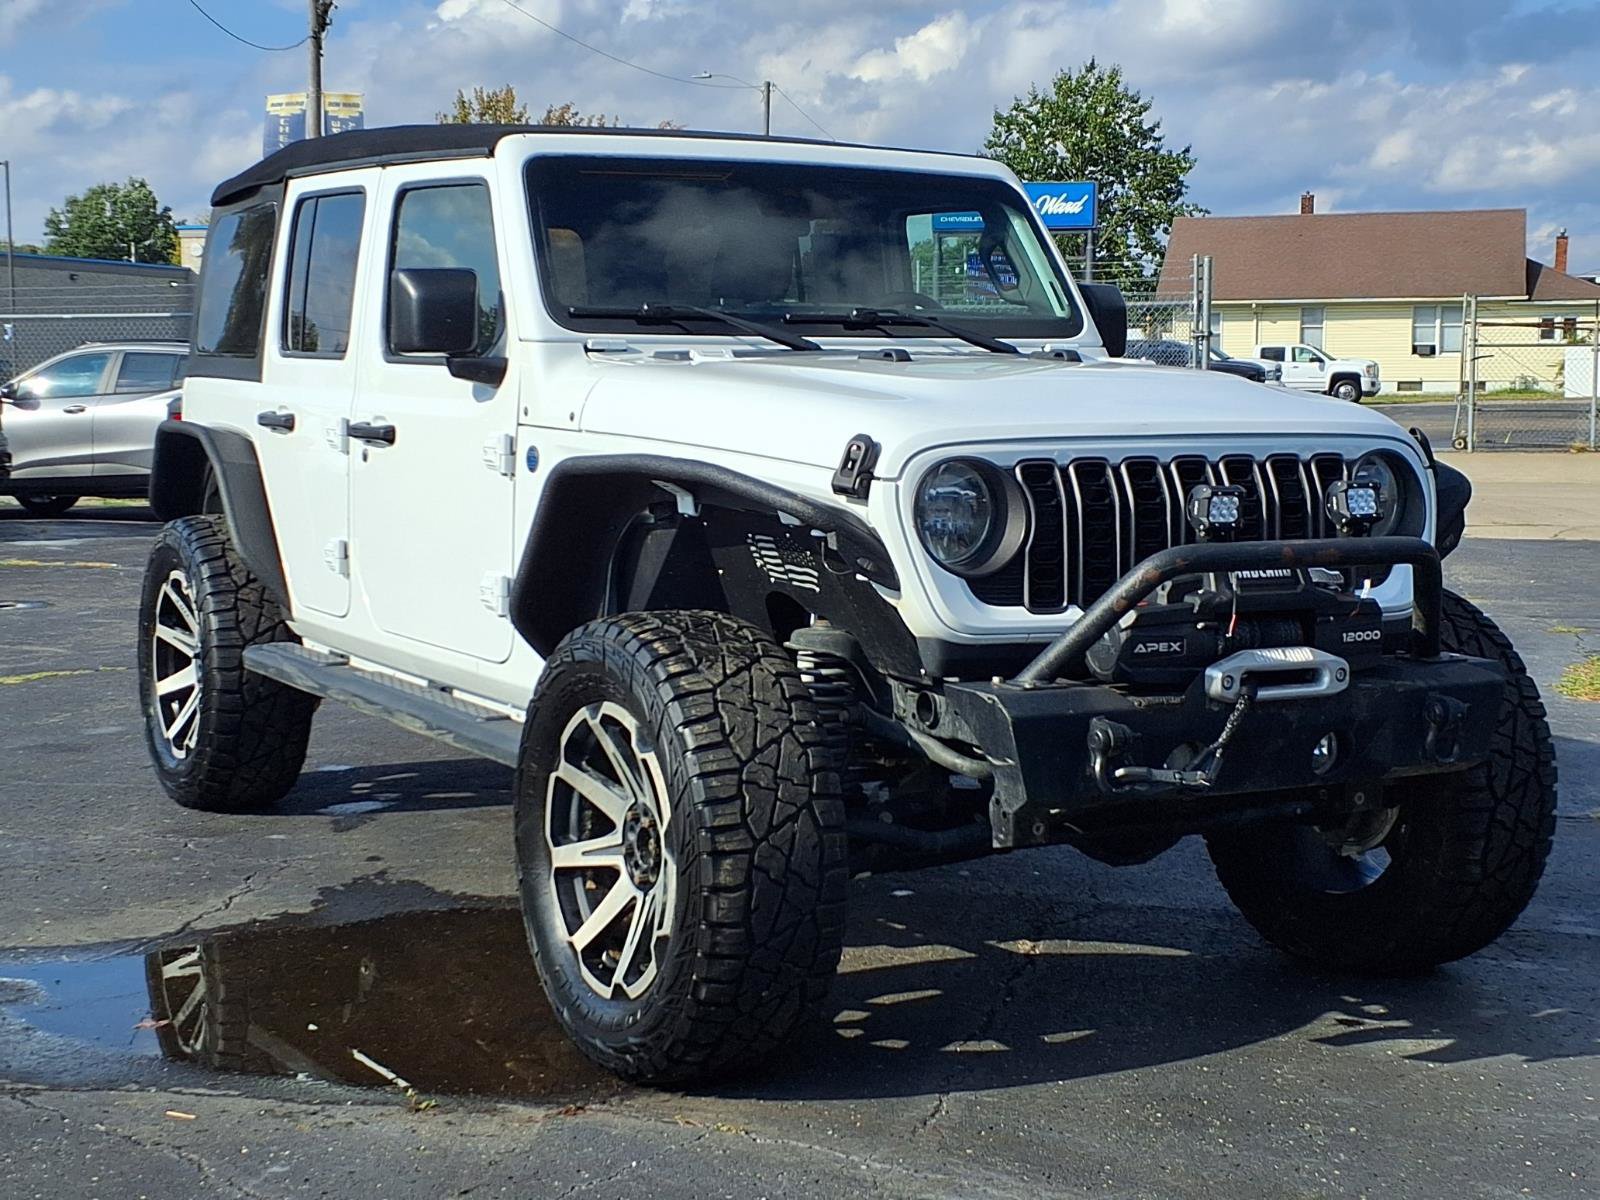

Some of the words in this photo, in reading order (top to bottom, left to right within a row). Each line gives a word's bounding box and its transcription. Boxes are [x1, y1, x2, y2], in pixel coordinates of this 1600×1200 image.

[1036, 193, 1089, 215] Ward
[1341, 630, 1382, 643] 12000
[1133, 641, 1182, 653] APEX
